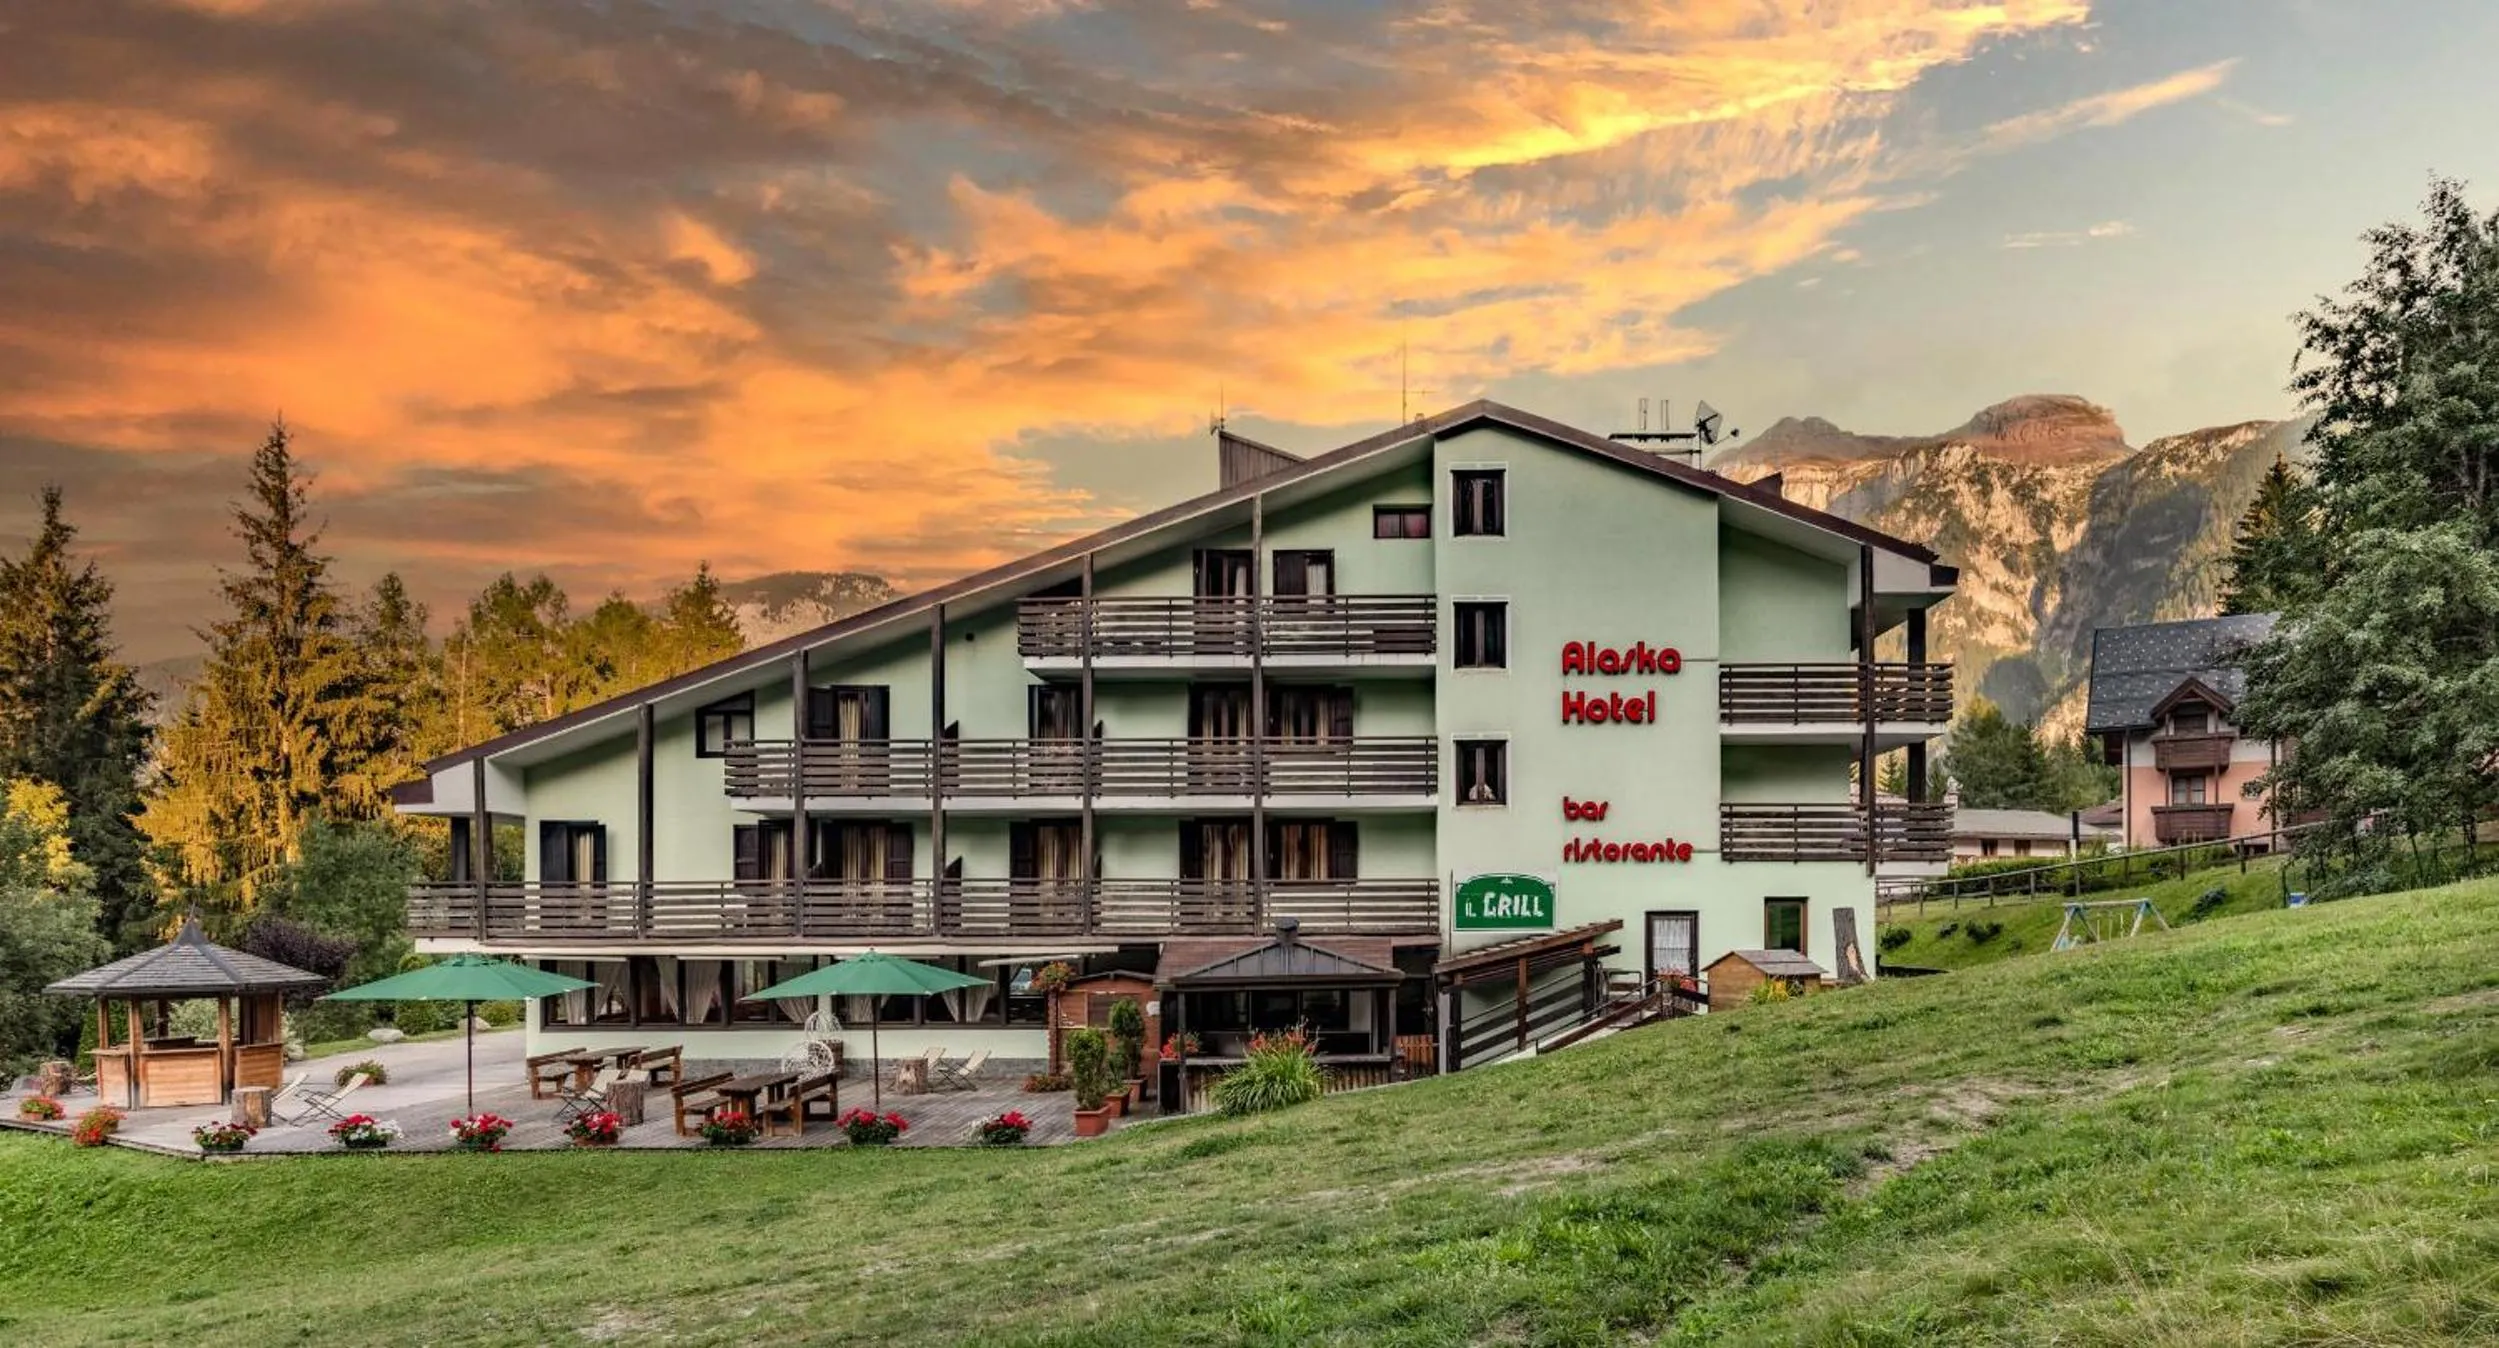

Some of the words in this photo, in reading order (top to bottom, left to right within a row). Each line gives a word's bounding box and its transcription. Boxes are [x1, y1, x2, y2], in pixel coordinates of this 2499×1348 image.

[1562, 640, 1682, 674] Alaska
[1562, 690, 1656, 724] Hotel
[1563, 797, 1609, 821] bar
[1563, 838, 1694, 862] ristorante
[1483, 891, 1545, 918] GRILL
